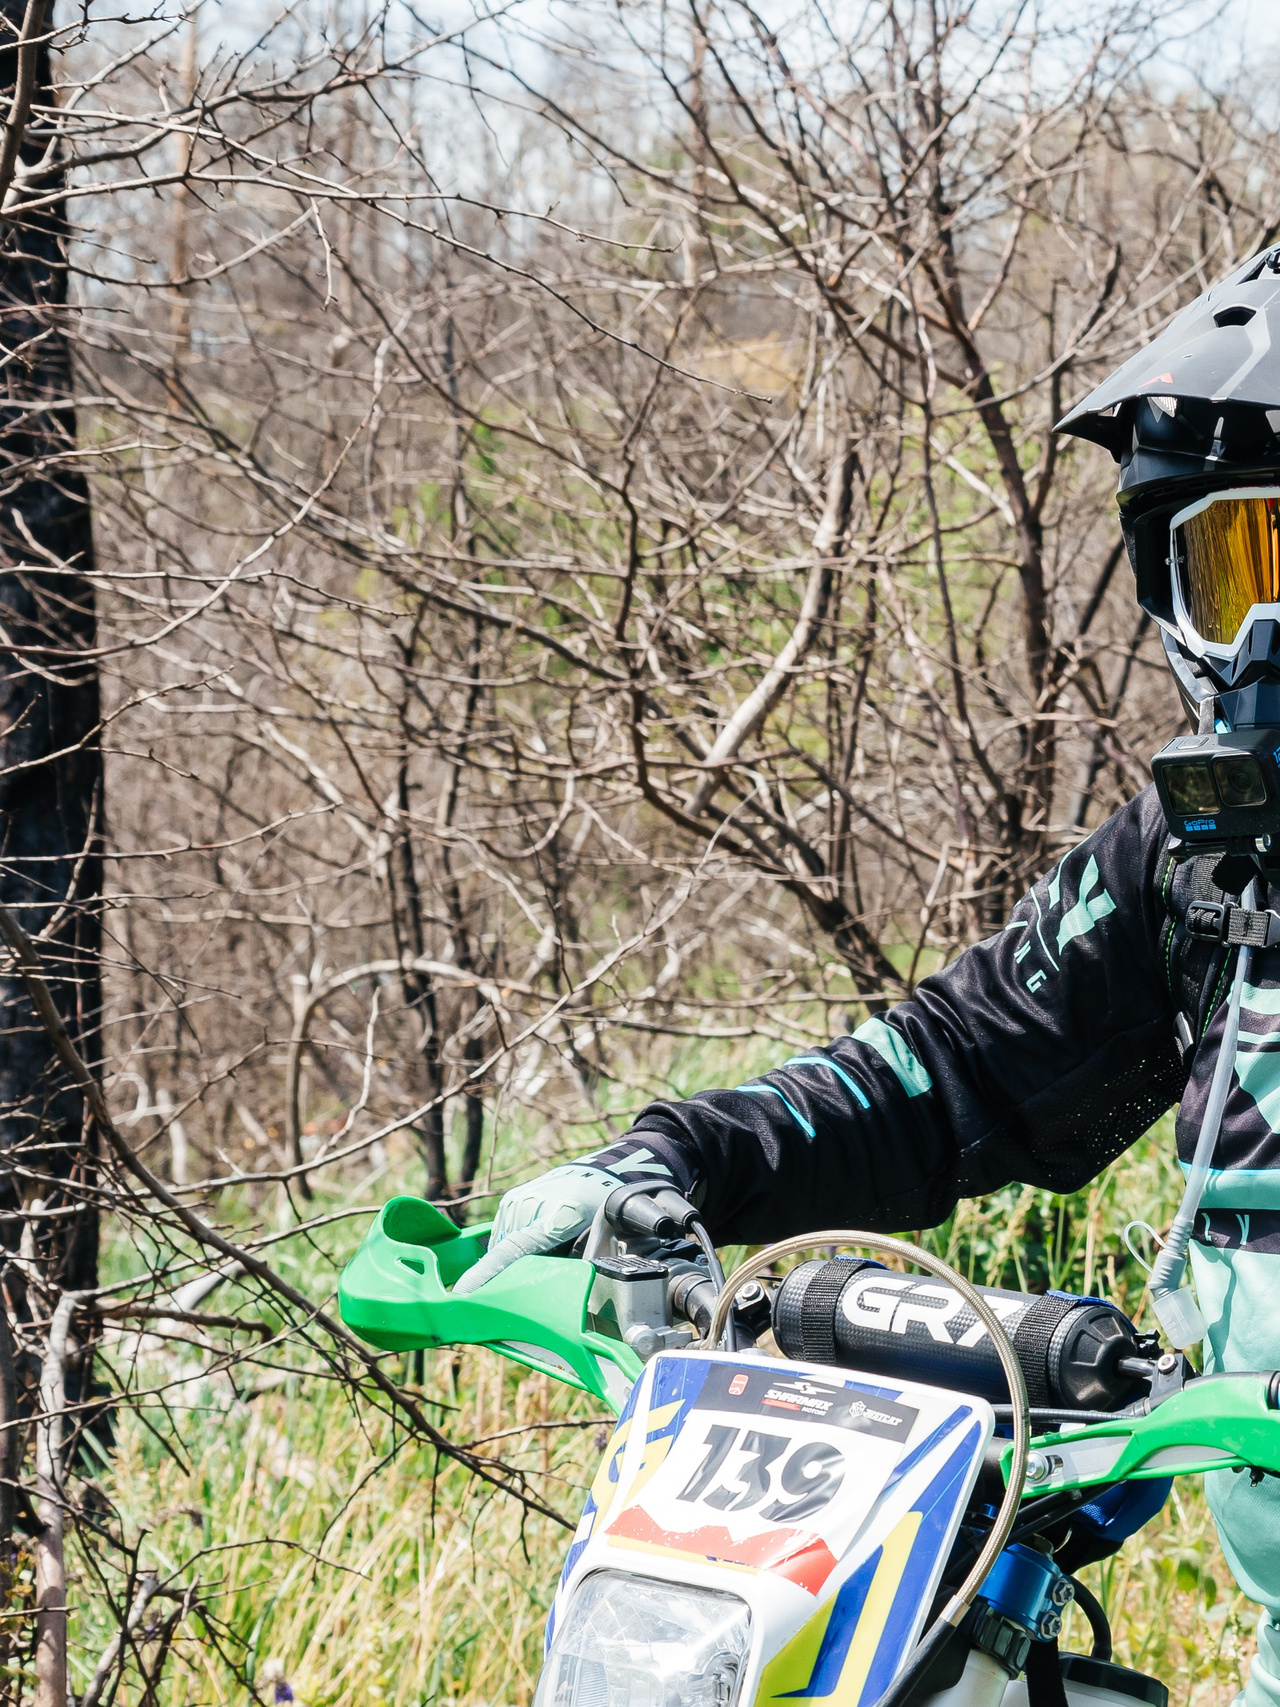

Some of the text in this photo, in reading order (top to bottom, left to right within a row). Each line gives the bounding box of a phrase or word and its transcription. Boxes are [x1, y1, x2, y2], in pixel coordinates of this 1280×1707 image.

[1201, 1212, 1250, 1246] LY
[802, 1406, 827, 1417] MOTORS
[676, 1424, 846, 1523] 139
